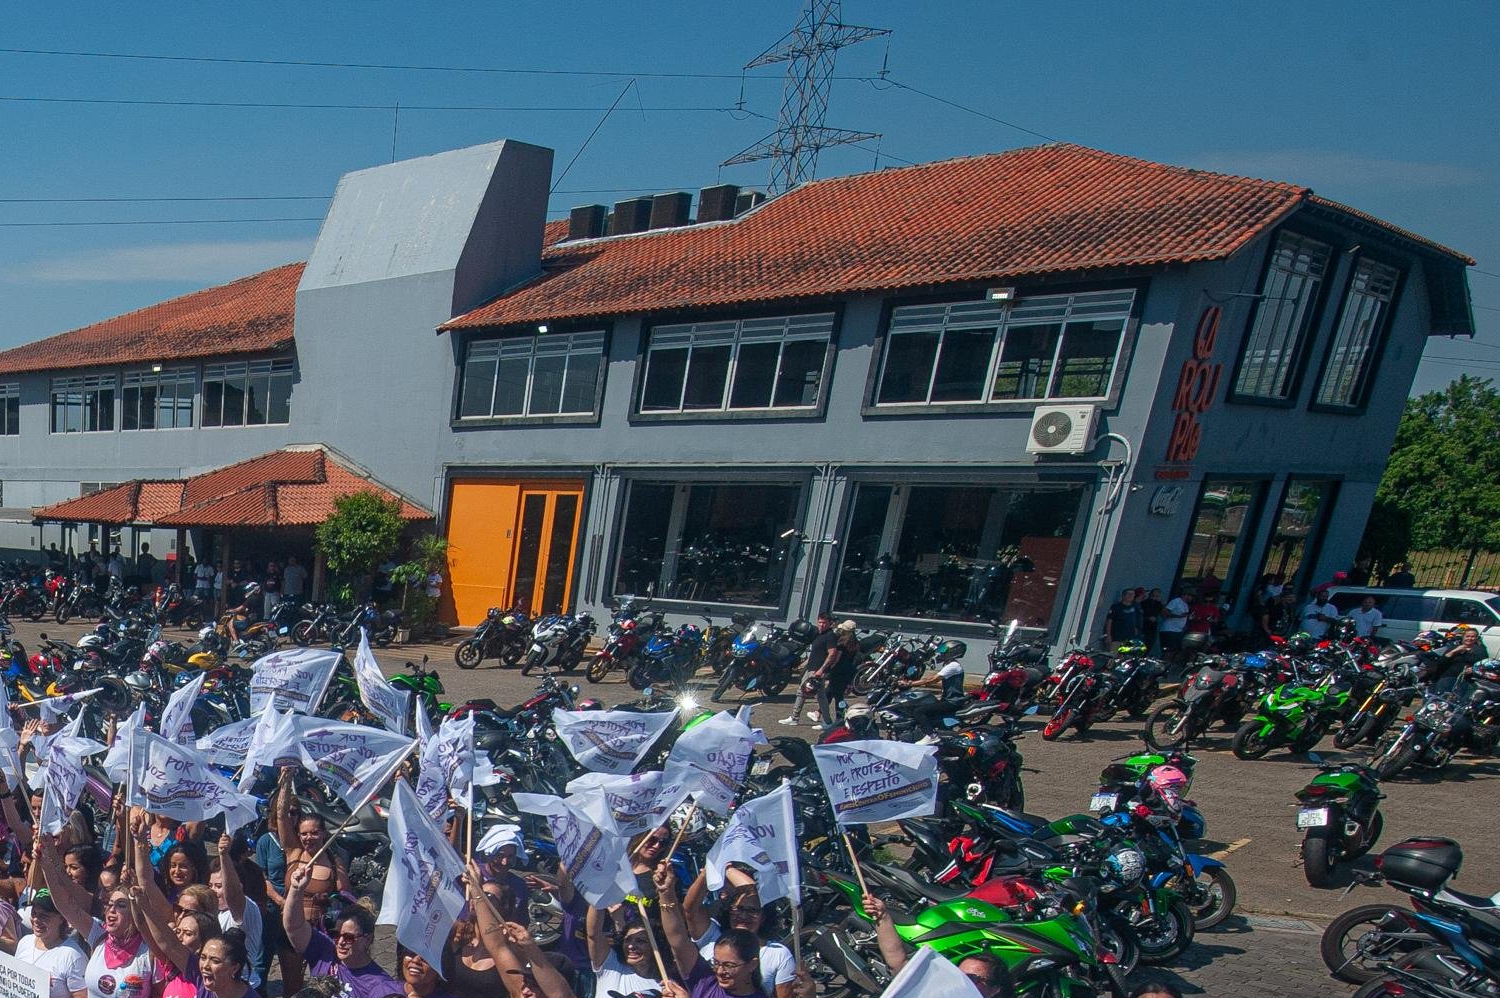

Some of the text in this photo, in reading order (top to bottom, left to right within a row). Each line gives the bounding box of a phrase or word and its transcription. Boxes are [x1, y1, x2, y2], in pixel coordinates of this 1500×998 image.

[165, 756, 194, 777] POR
[829, 759, 899, 787] VOZ, PROTEÇ
[852, 773, 901, 797] RESPEITO
[7, 967, 18, 980] POR
[18, 973, 36, 989] TODAS
